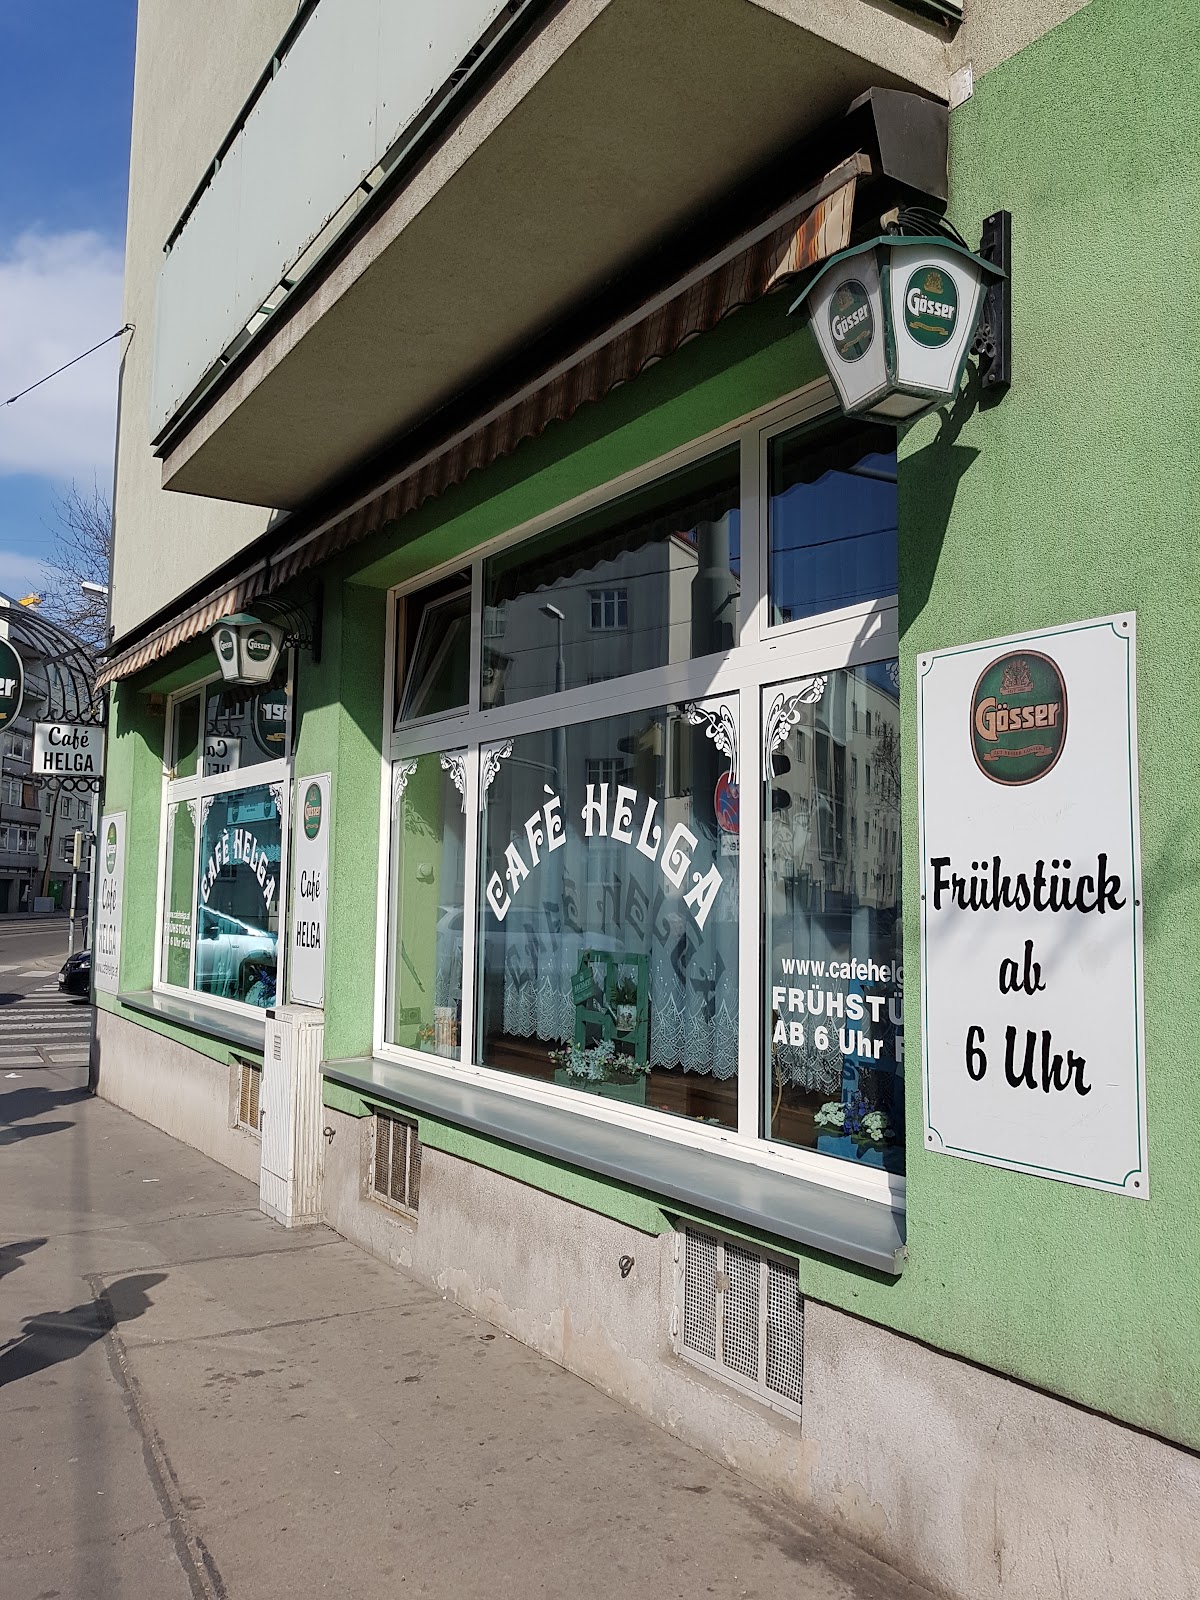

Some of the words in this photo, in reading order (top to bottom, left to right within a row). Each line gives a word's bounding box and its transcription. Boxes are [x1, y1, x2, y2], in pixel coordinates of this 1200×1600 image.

[907, 287, 955, 319] Gösser
[832, 303, 869, 341] Gösser
[248, 638, 270, 651] Gösser
[975, 696, 1059, 742] Gösser
[48, 726, 90, 750] Café
[43, 751, 94, 772] HELGA
[233, 829, 276, 910] HELGA
[582, 783, 723, 931] HELGA
[102, 878, 117, 915] Café
[300, 870, 321, 902] Café
[930, 853, 1127, 914] Frühstück
[98, 923, 117, 956] HELGA
[297, 921, 321, 949] HELGA
[999, 939, 1047, 995] ab
[772, 1020, 805, 1047] AB
[814, 1025, 829, 1051] 6
[839, 1028, 884, 1059] Uhr
[966, 1025, 987, 1081] 6
[1004, 1025, 1092, 1096] Uhr
